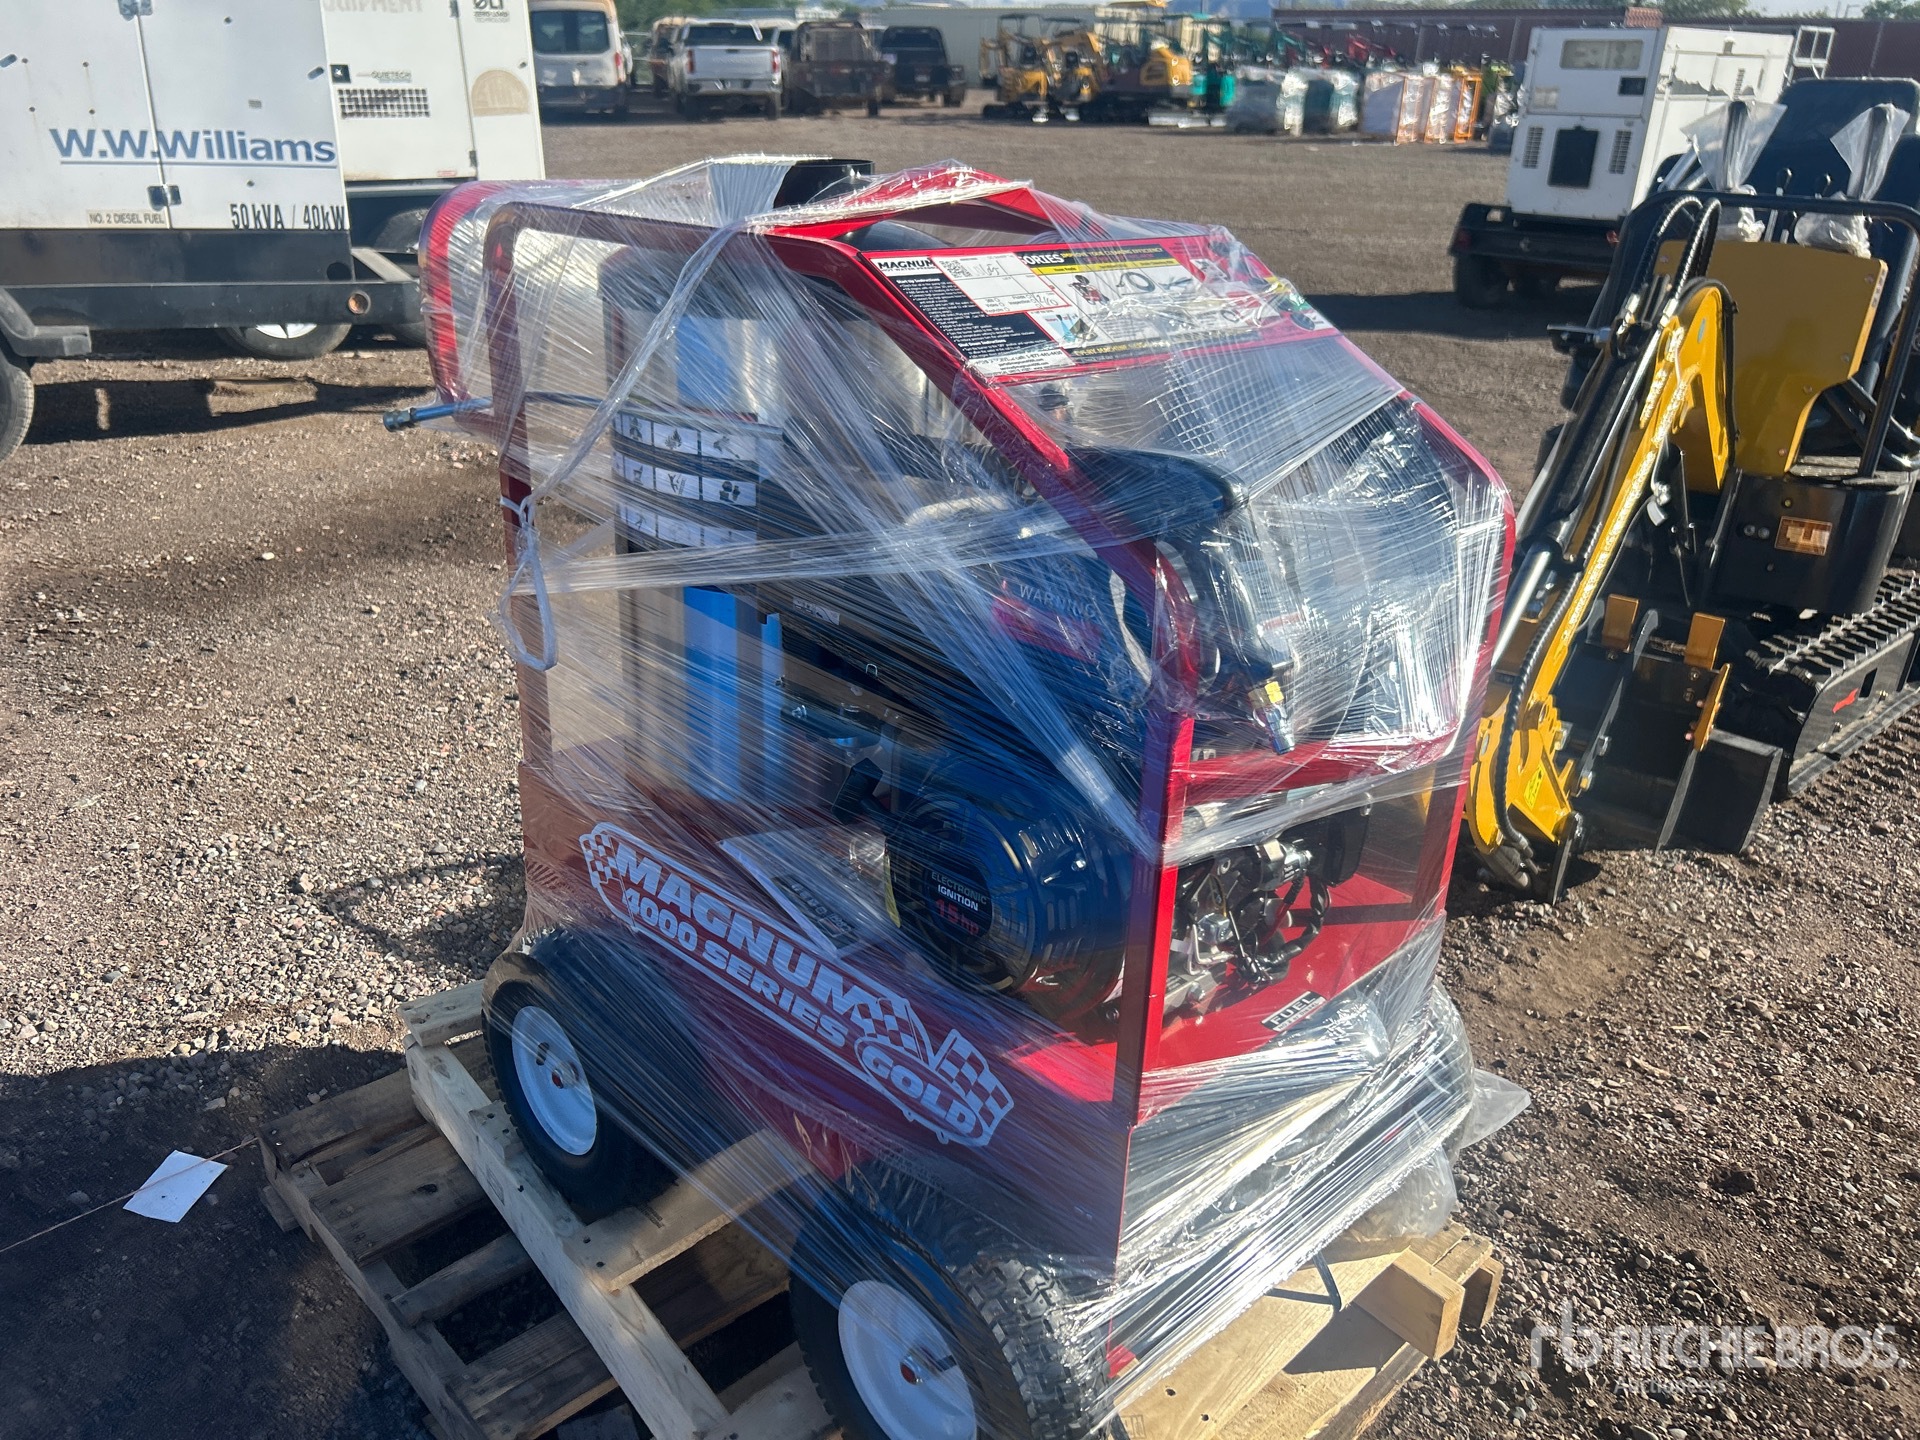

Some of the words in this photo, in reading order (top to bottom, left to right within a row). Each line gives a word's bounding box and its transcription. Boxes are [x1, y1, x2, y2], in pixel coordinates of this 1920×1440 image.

[89, 213, 105, 224] NO.
[106, 214, 113, 224] 2
[114, 213, 142, 224] DIESEL
[143, 213, 165, 224] FUEL
[931, 871, 988, 905] ELECTRONIC
[937, 884, 979, 911] IGNITION
[614, 843, 876, 1017] MAGNUM
[622, 887, 699, 953] 4000
[702, 940, 849, 1048] SERIES
[1269, 997, 1316, 1026] FUEL
[863, 1049, 977, 1134] GOLD
